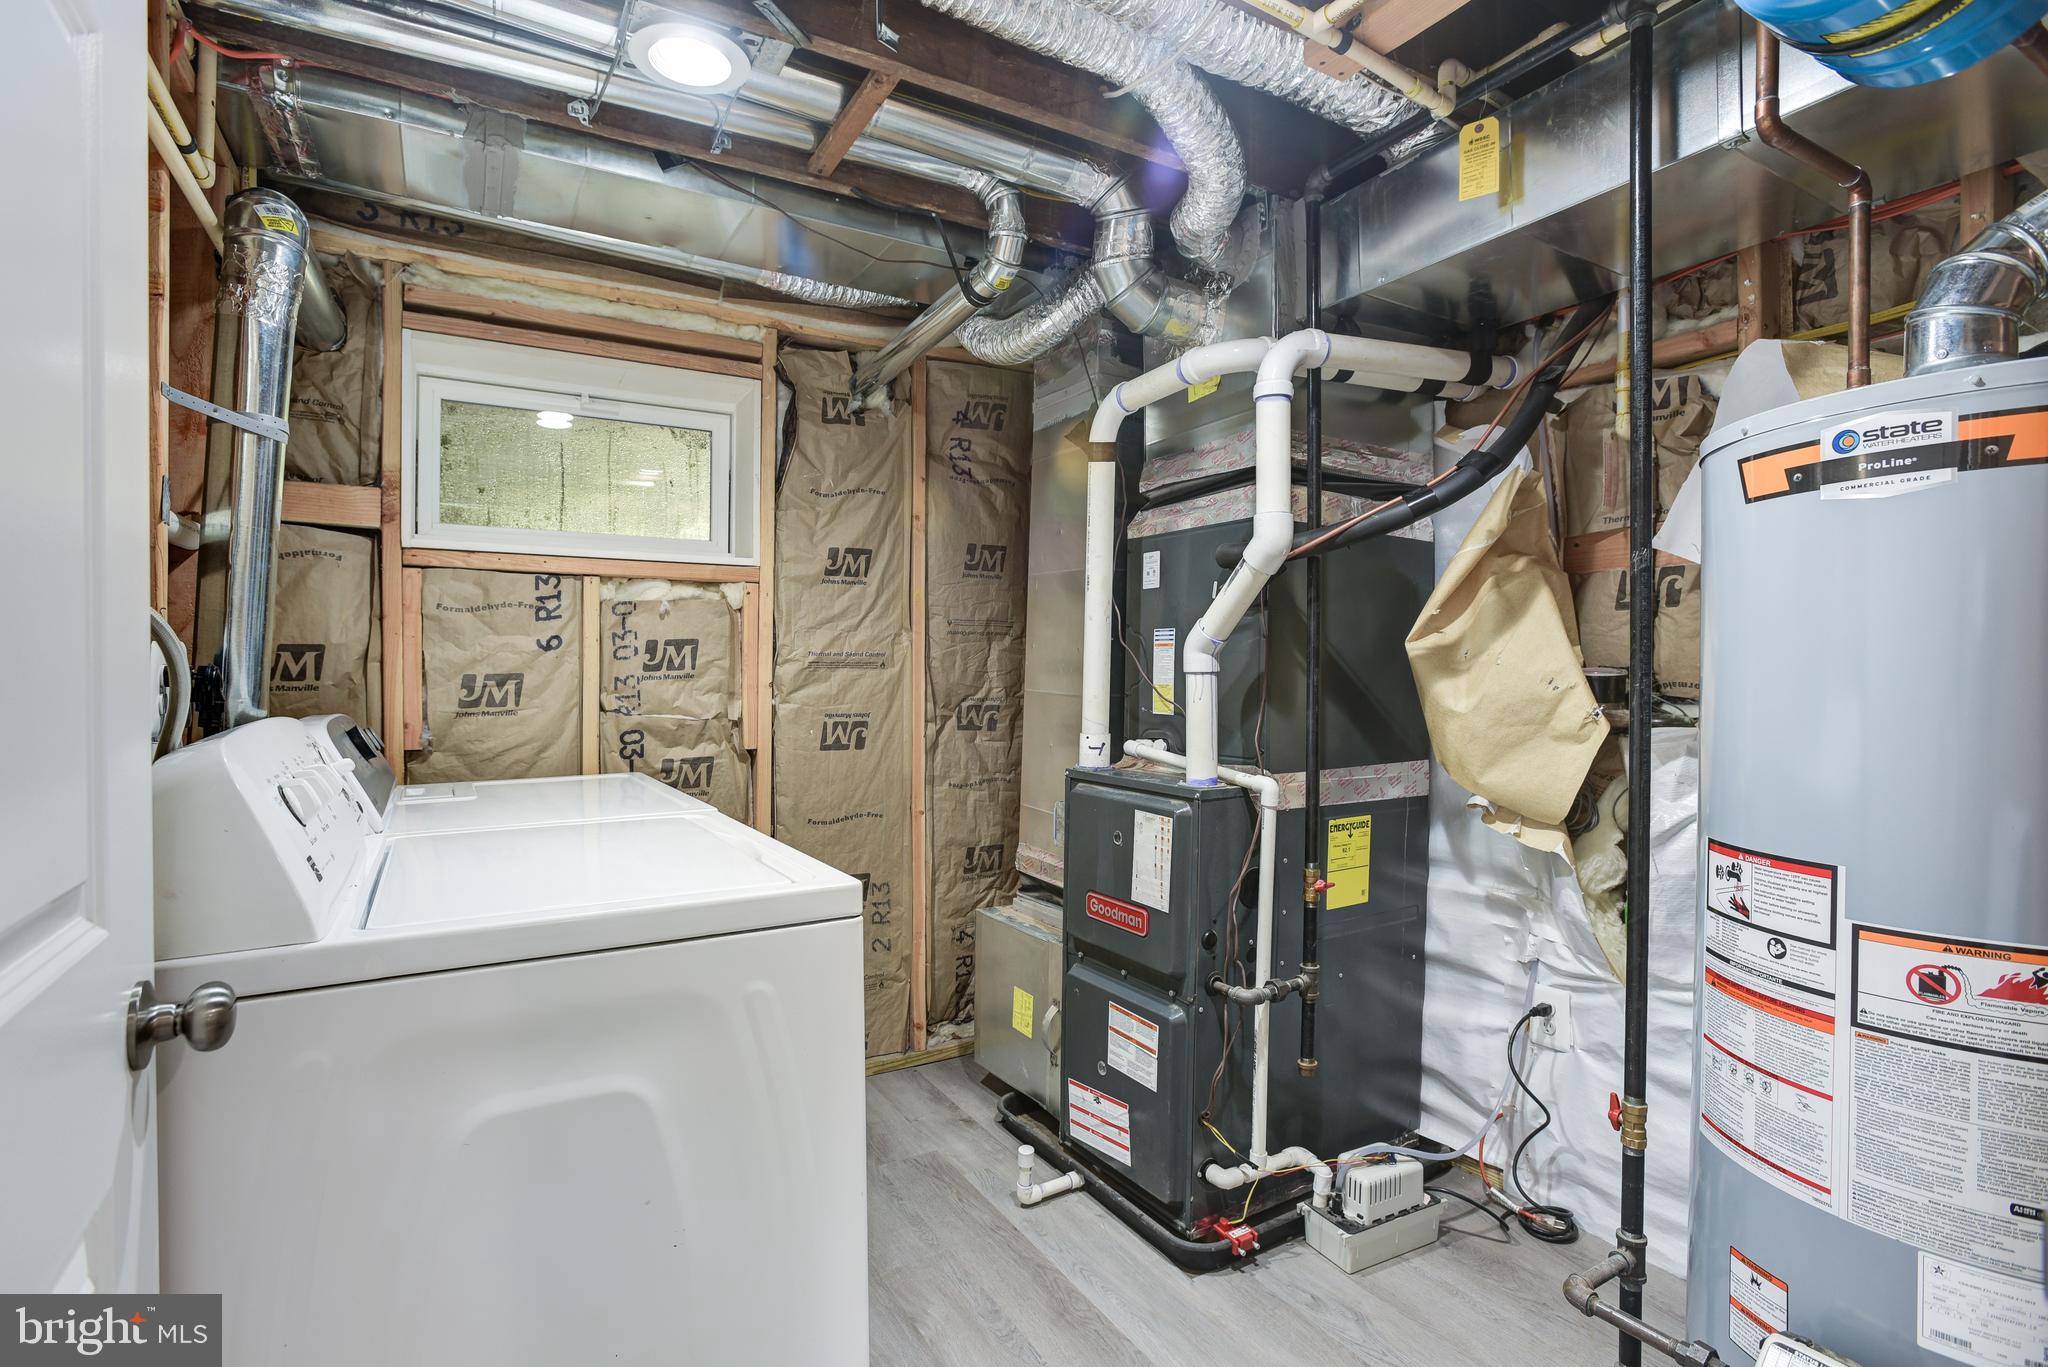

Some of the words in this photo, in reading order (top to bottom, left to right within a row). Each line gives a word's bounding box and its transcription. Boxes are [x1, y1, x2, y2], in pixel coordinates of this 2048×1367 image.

[1862, 419, 1943, 443] state
[1862, 438, 1895, 449] WATER
[1896, 432, 1943, 444] HEATERS
[1840, 480, 1895, 492] COMMERCIAL
[1900, 474, 1932, 484] GRADE
[824, 547, 872, 578] JM
[964, 543, 1007, 573] JM
[820, 578, 840, 586] Johns
[841, 578, 868, 586] Manville
[534, 574, 563, 622] R13
[536, 634, 563, 652] 6
[643, 639, 699, 672] JM
[640, 673, 662, 682] Johns
[663, 672, 696, 681] Manville
[275, 684, 320, 692] Manville
[457, 673, 525, 709] JM
[453, 710, 481, 720] Johns
[480, 709, 519, 718] Manville
[819, 720, 869, 751] JM
[660, 756, 714, 789] JM
[807, 812, 884, 826] Formaldehyde-Free
[963, 844, 1004, 874] JM
[1745, 855, 1772, 867] DANGER
[872, 881, 892, 926] R13
[1090, 898, 1142, 928] Goodman
[872, 938, 892, 953] 2
[1955, 946, 2012, 961] WARNING
[1980, 1002, 2018, 1012] Flammable
[2020, 1007, 2045, 1015] Vapors
[1961, 1014, 1994, 1023] EXPLOSION
